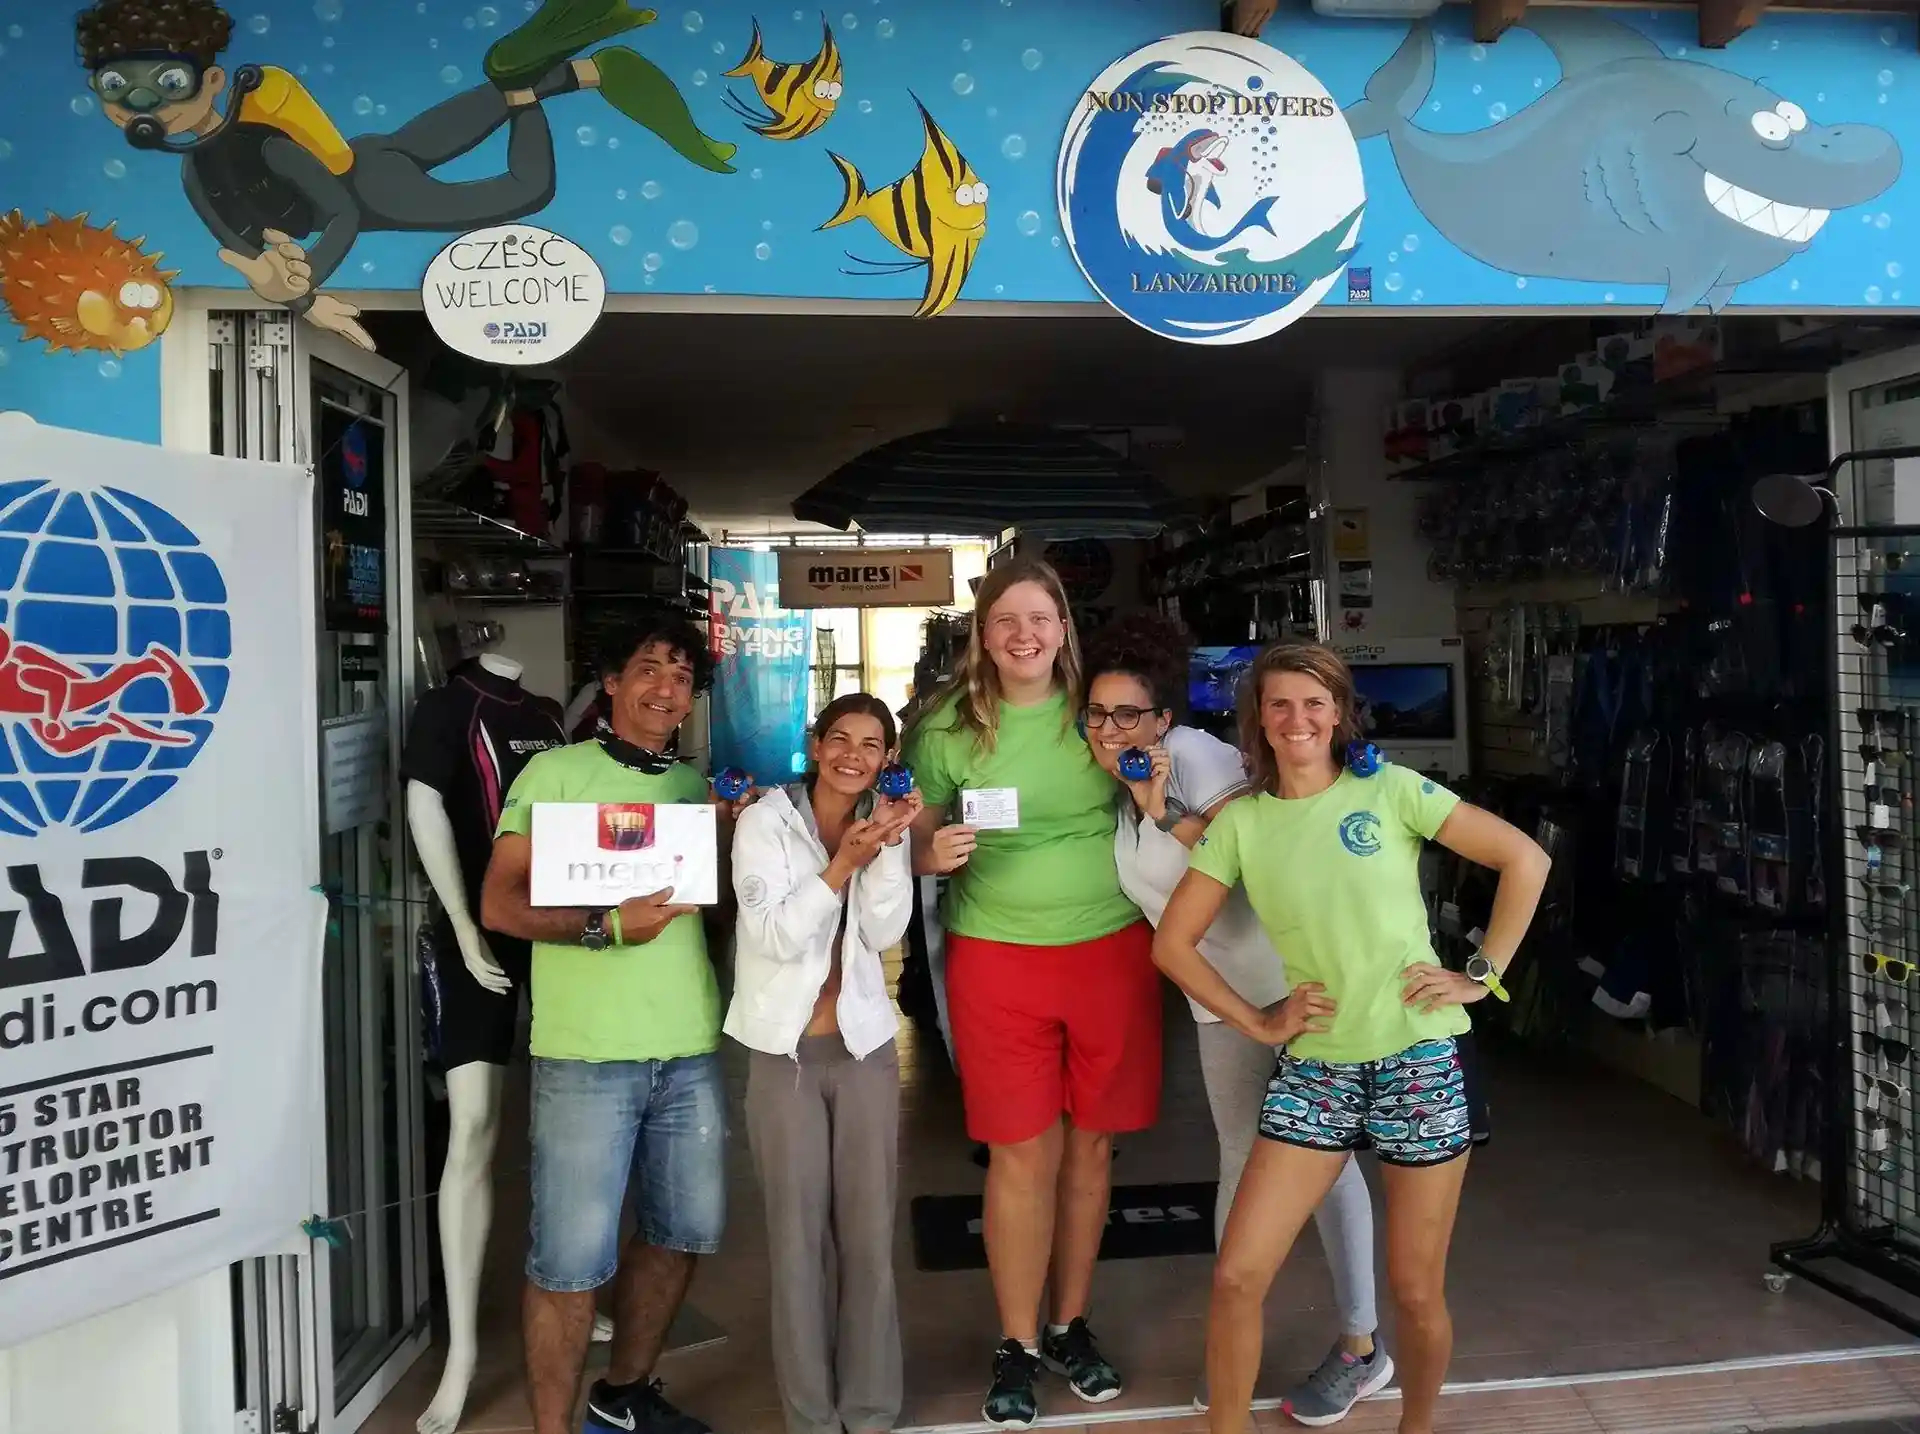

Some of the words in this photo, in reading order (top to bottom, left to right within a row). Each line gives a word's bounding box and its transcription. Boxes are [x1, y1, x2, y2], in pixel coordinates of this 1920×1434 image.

[1087, 91, 1142, 113] NON
[1152, 92, 1225, 115] STOP
[1231, 95, 1334, 117] DIVERS
[436, 275, 589, 308] WELCOME
[1131, 272, 1297, 293] LANZAROTE
[1350, 290, 1370, 299] PADI
[503, 322, 547, 337] PADI
[343, 488, 368, 517] PADI
[808, 566, 891, 583] mares
[712, 578, 805, 619] PAD
[713, 622, 803, 642] DIVING
[713, 638, 736, 655] IS
[745, 641, 803, 657] FUN
[568, 854, 684, 881] merci
[34, 1077, 140, 1127] STAR
[0, 1190, 153, 1263] CENTRE
